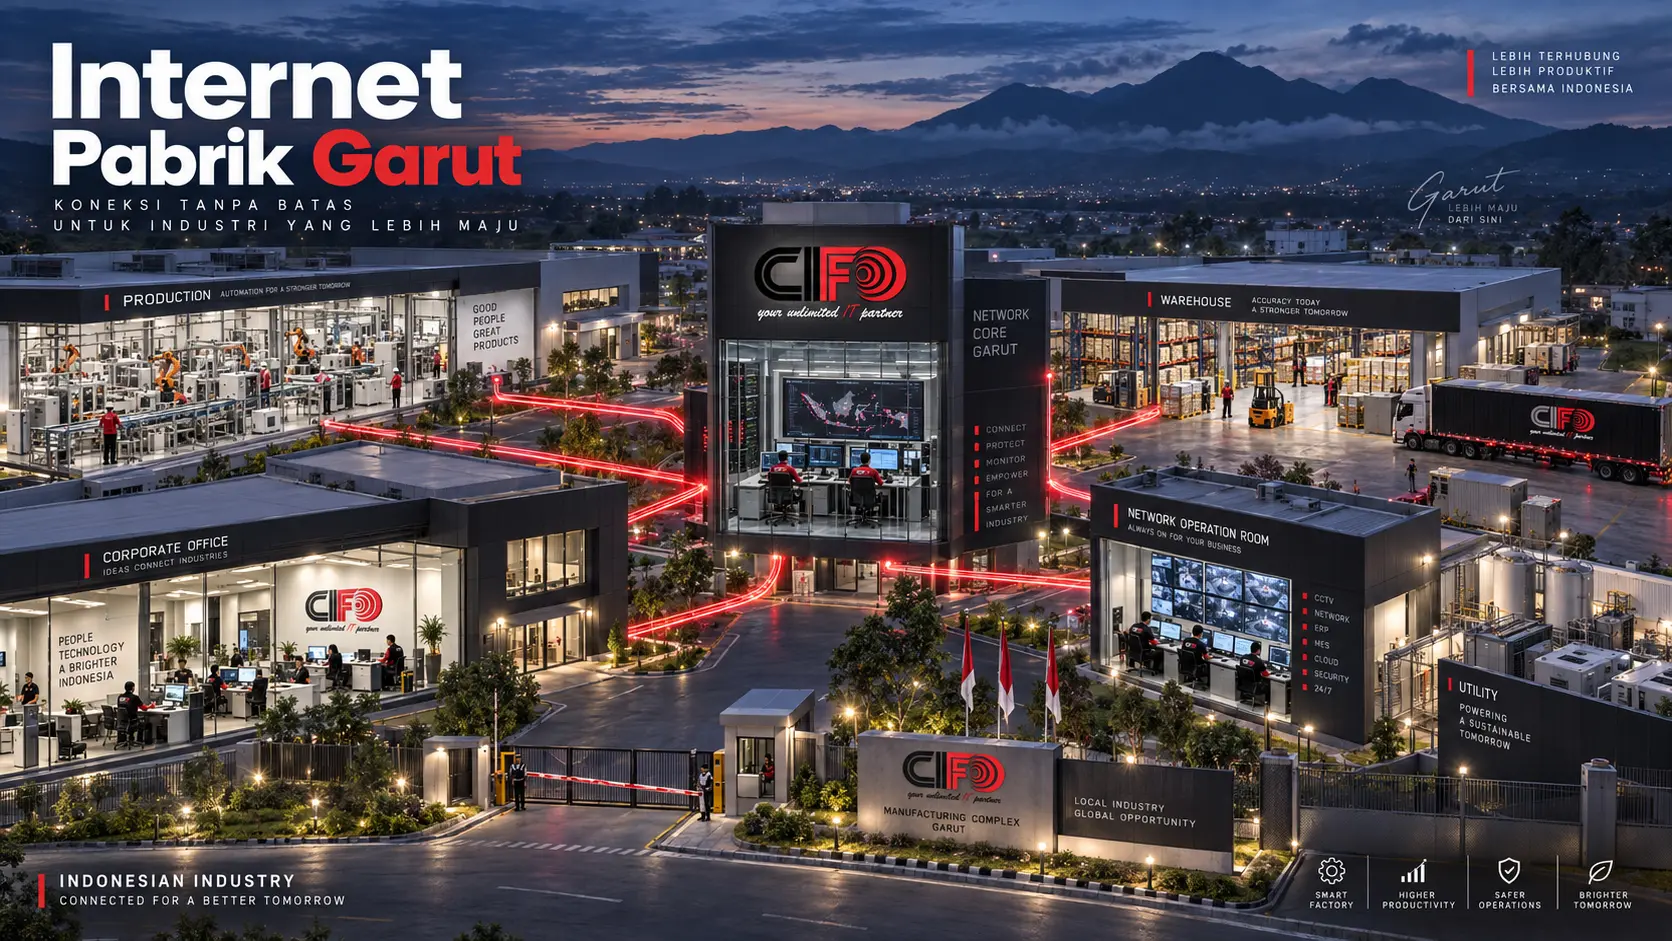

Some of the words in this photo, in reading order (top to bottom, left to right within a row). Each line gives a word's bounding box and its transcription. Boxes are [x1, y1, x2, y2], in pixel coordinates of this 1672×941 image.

[754, 246, 907, 302] CIFO
[123, 290, 211, 307] PRODUCTION
[220, 288, 264, 298] AUTOMATION
[265, 286, 278, 294] FOR
[473, 302, 497, 314] GOOD
[1160, 295, 1232, 308] WAREHOUSE
[1251, 297, 1291, 305] ACCURACY
[757, 307, 783, 321] your
[786, 306, 840, 318] unlimited
[842, 303, 860, 318] IT
[859, 307, 904, 321] partner
[973, 308, 1030, 322] NETWORK
[1260, 307, 1300, 315] STRONGER
[1304, 308, 1349, 317] TOMORROW
[473, 313, 506, 326] PEOPLE
[473, 326, 501, 339] GREAT
[973, 326, 1007, 340] CORE
[473, 335, 519, 351] PRODUCTS
[973, 343, 1018, 358] GARUT
[986, 423, 1027, 434] CONNECT
[986, 439, 1026, 450] PROTECT
[986, 455, 1026, 467] MONITOR
[986, 470, 1029, 482] EMPOWER
[986, 489, 1003, 498] FOR
[986, 501, 1027, 514] SMARTER
[986, 515, 1028, 528] INDUSTRY
[1127, 507, 1176, 527] NETWORK
[1180, 518, 1237, 539] OPERATION
[1240, 530, 1270, 546] ROOM
[1127, 524, 1155, 536] ALWAYS
[1157, 529, 1167, 538] ON
[1169, 532, 1183, 542] FOR
[1186, 536, 1205, 547] YOUR
[1207, 540, 1242, 555] BUSINESS
[103, 541, 181, 564] CORPORATE
[187, 535, 228, 551] OFFICE
[103, 565, 130, 576] IDEAS
[134, 558, 174, 571] CONNECT
[179, 551, 228, 565] INDUSTRIES
[305, 587, 383, 622] CIFO
[1314, 594, 1334, 605] CCTV
[1314, 609, 1350, 624] NETWORK
[1314, 624, 1329, 633] ERP
[58, 632, 93, 646] PEOPLE
[1314, 640, 1330, 650] MES
[59, 641, 125, 660] TECHNOLOGY
[59, 664, 66, 674] A
[69, 656, 118, 673] BRIGHTER
[1314, 655, 1339, 666] CLOUD
[59, 670, 114, 688] INDONESIA
[1314, 670, 1350, 684] SECURITY
[1314, 685, 1332, 695] 24/7
[1459, 681, 1498, 701] UTILITY
[1459, 703, 1508, 723] POWERING
[1459, 716, 1465, 725] A
[1469, 718, 1531, 743] SUSTAINABLE
[1459, 729, 1511, 750] TOMORROW
[902, 750, 1006, 793] CIFO
[1074, 796, 1107, 808] LOCAL
[1112, 800, 1165, 813] INDUSTRY
[883, 806, 966, 822] MANUFACTURING
[971, 814, 1020, 827] COMPLEX
[1074, 809, 1115, 821] GLOBAL
[1120, 813, 1196, 828] OPPORTUNITY
[932, 822, 965, 834] GARUT
